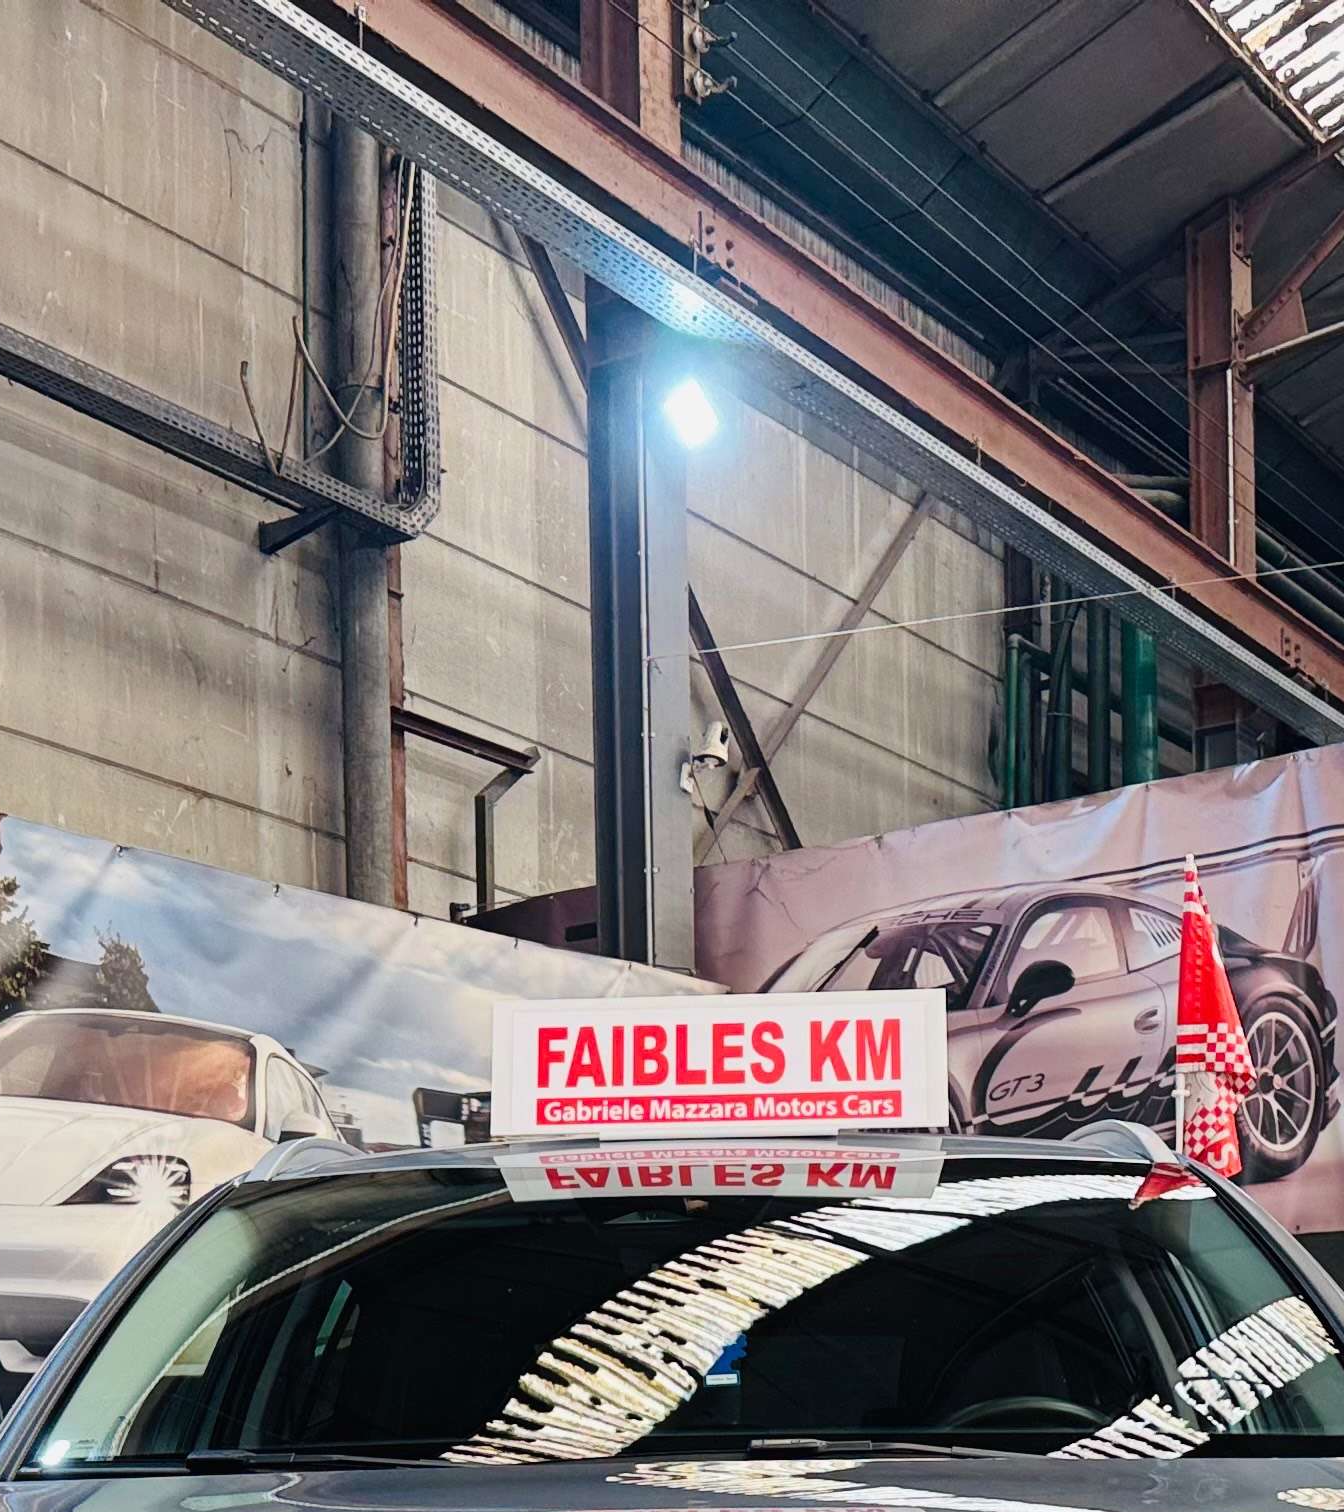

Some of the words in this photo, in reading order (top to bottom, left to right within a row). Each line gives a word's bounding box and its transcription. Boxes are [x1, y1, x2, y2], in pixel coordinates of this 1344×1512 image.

[536, 1020, 787, 1089] FAIBLES
[809, 1018, 902, 1083] KM
[544, 1101, 644, 1122] Gabriele
[650, 1098, 748, 1120] Mazzara
[754, 1094, 837, 1117] Motors
[842, 1092, 895, 1116] Cars
